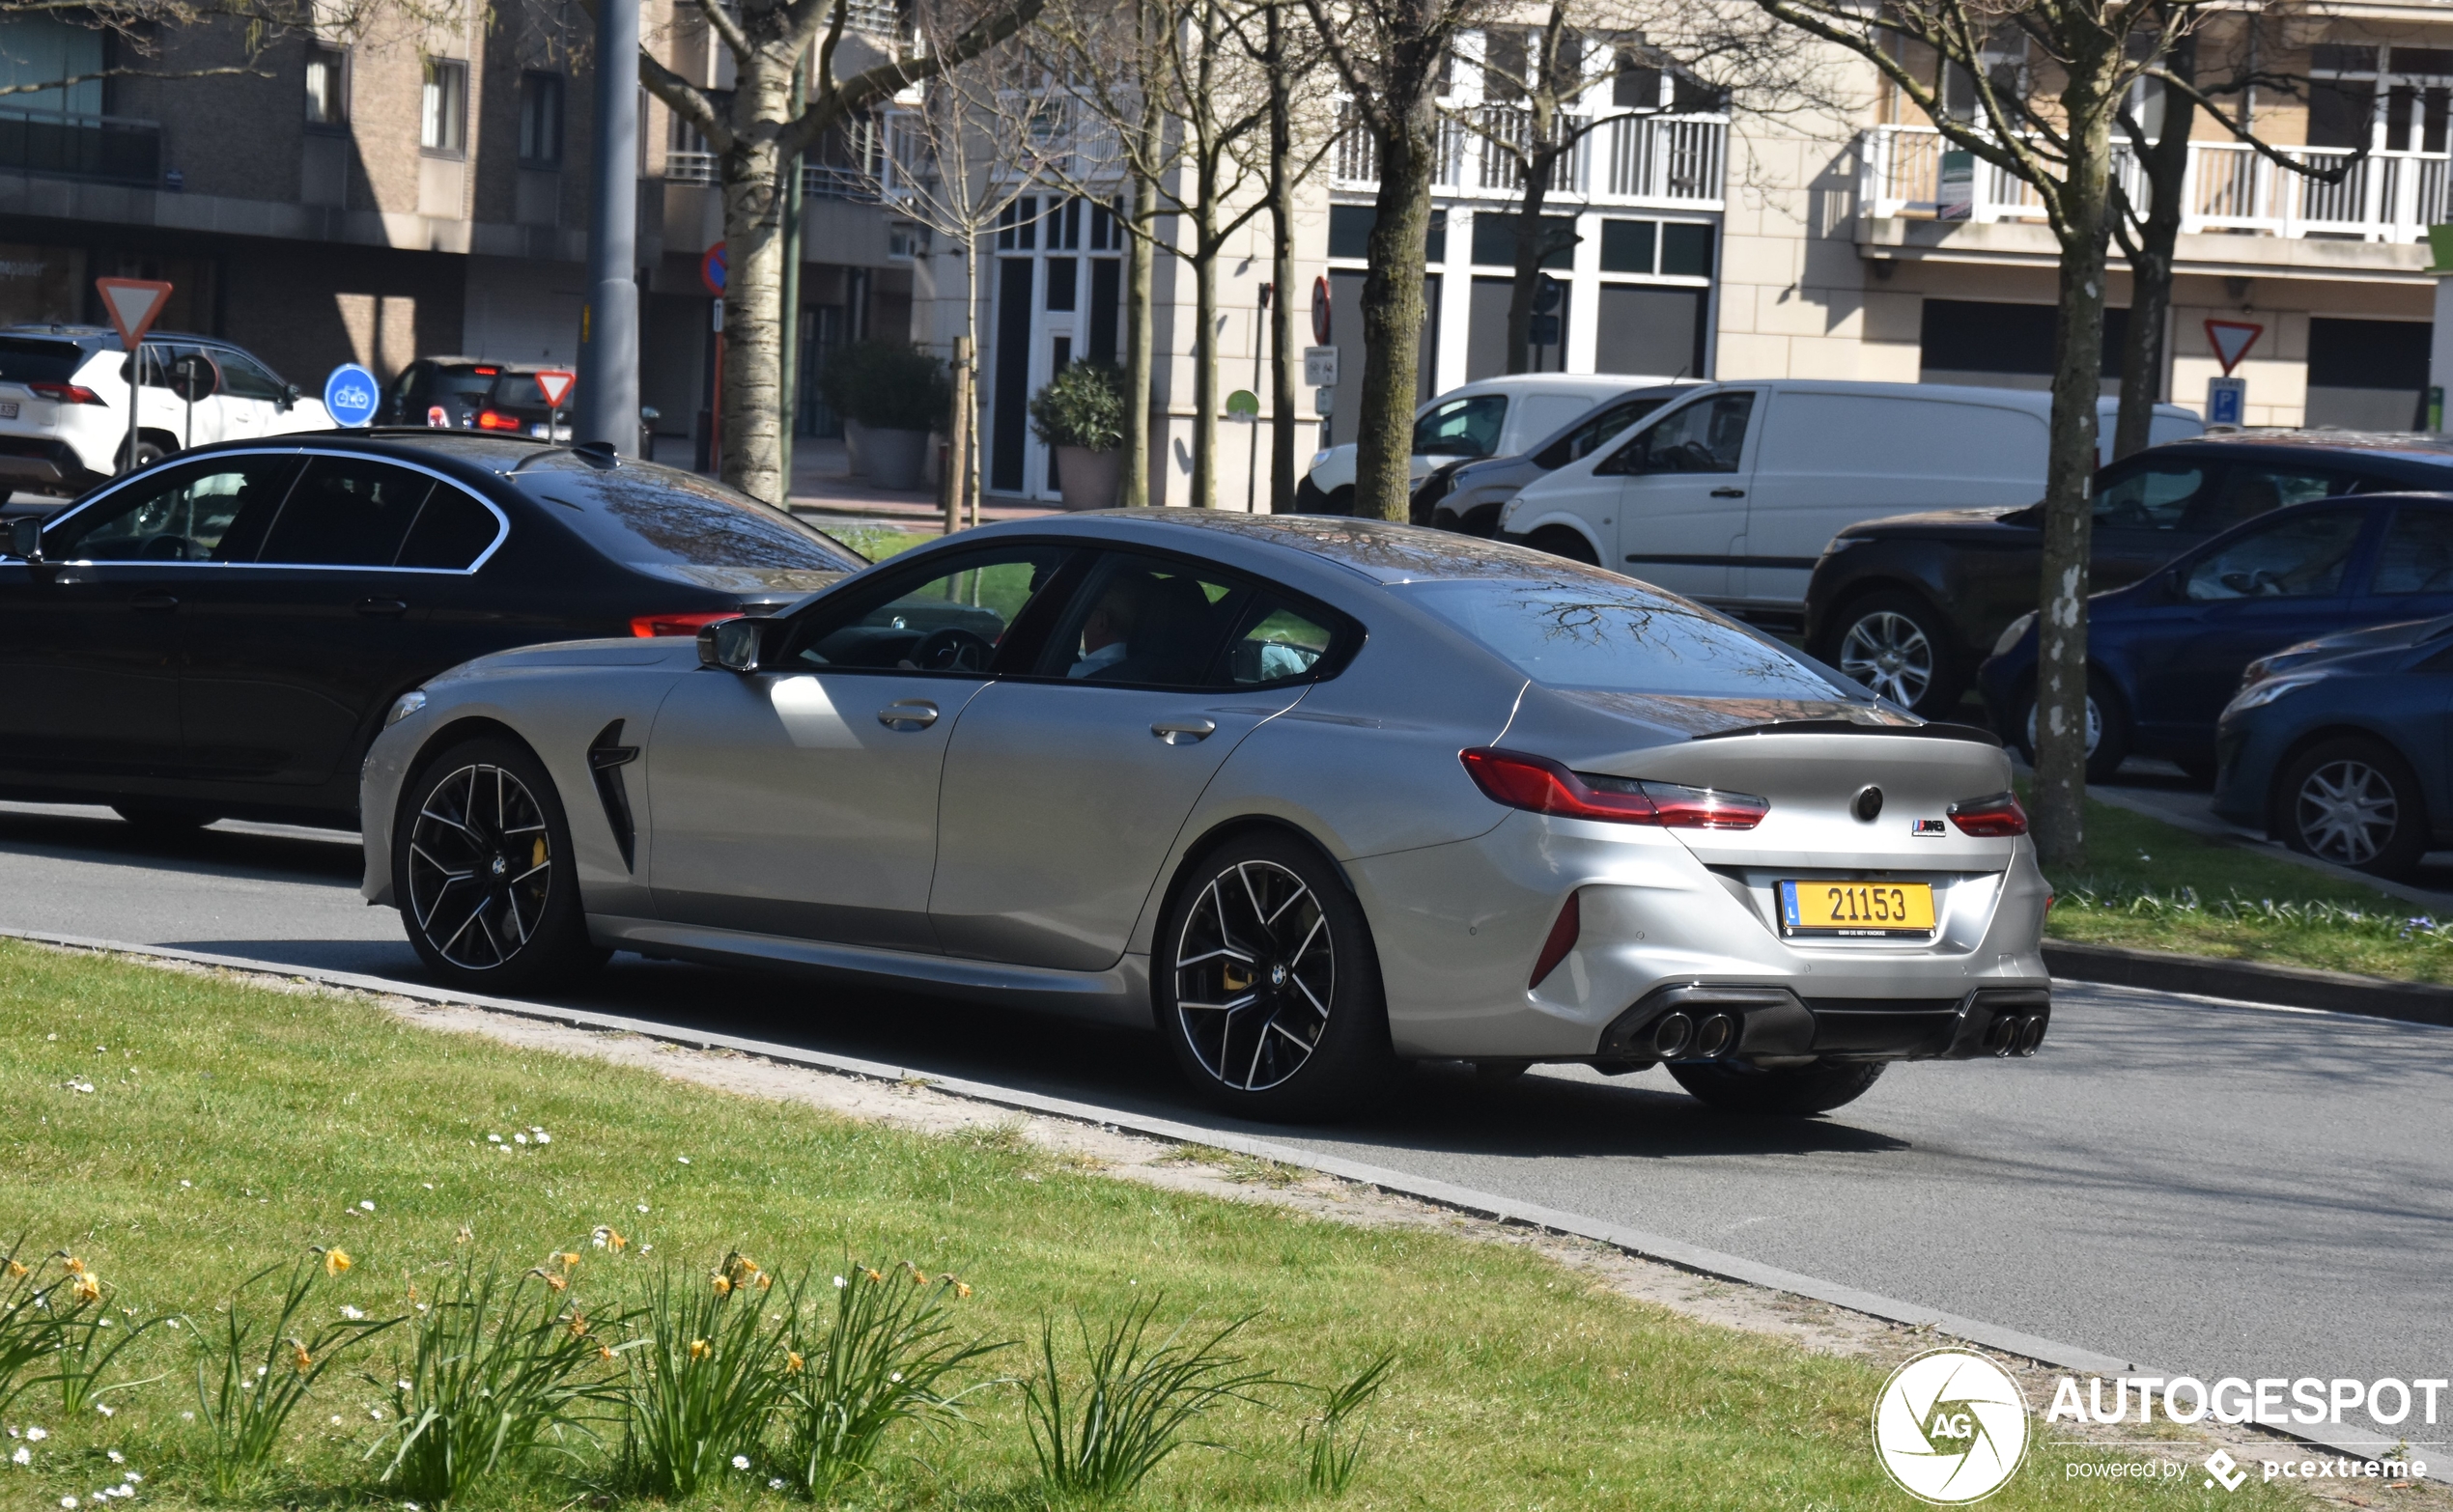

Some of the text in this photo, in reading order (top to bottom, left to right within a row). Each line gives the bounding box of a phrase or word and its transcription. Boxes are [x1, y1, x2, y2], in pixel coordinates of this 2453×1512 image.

[2220, 392, 2233, 409] P
[1789, 887, 1906, 921] L 21153
